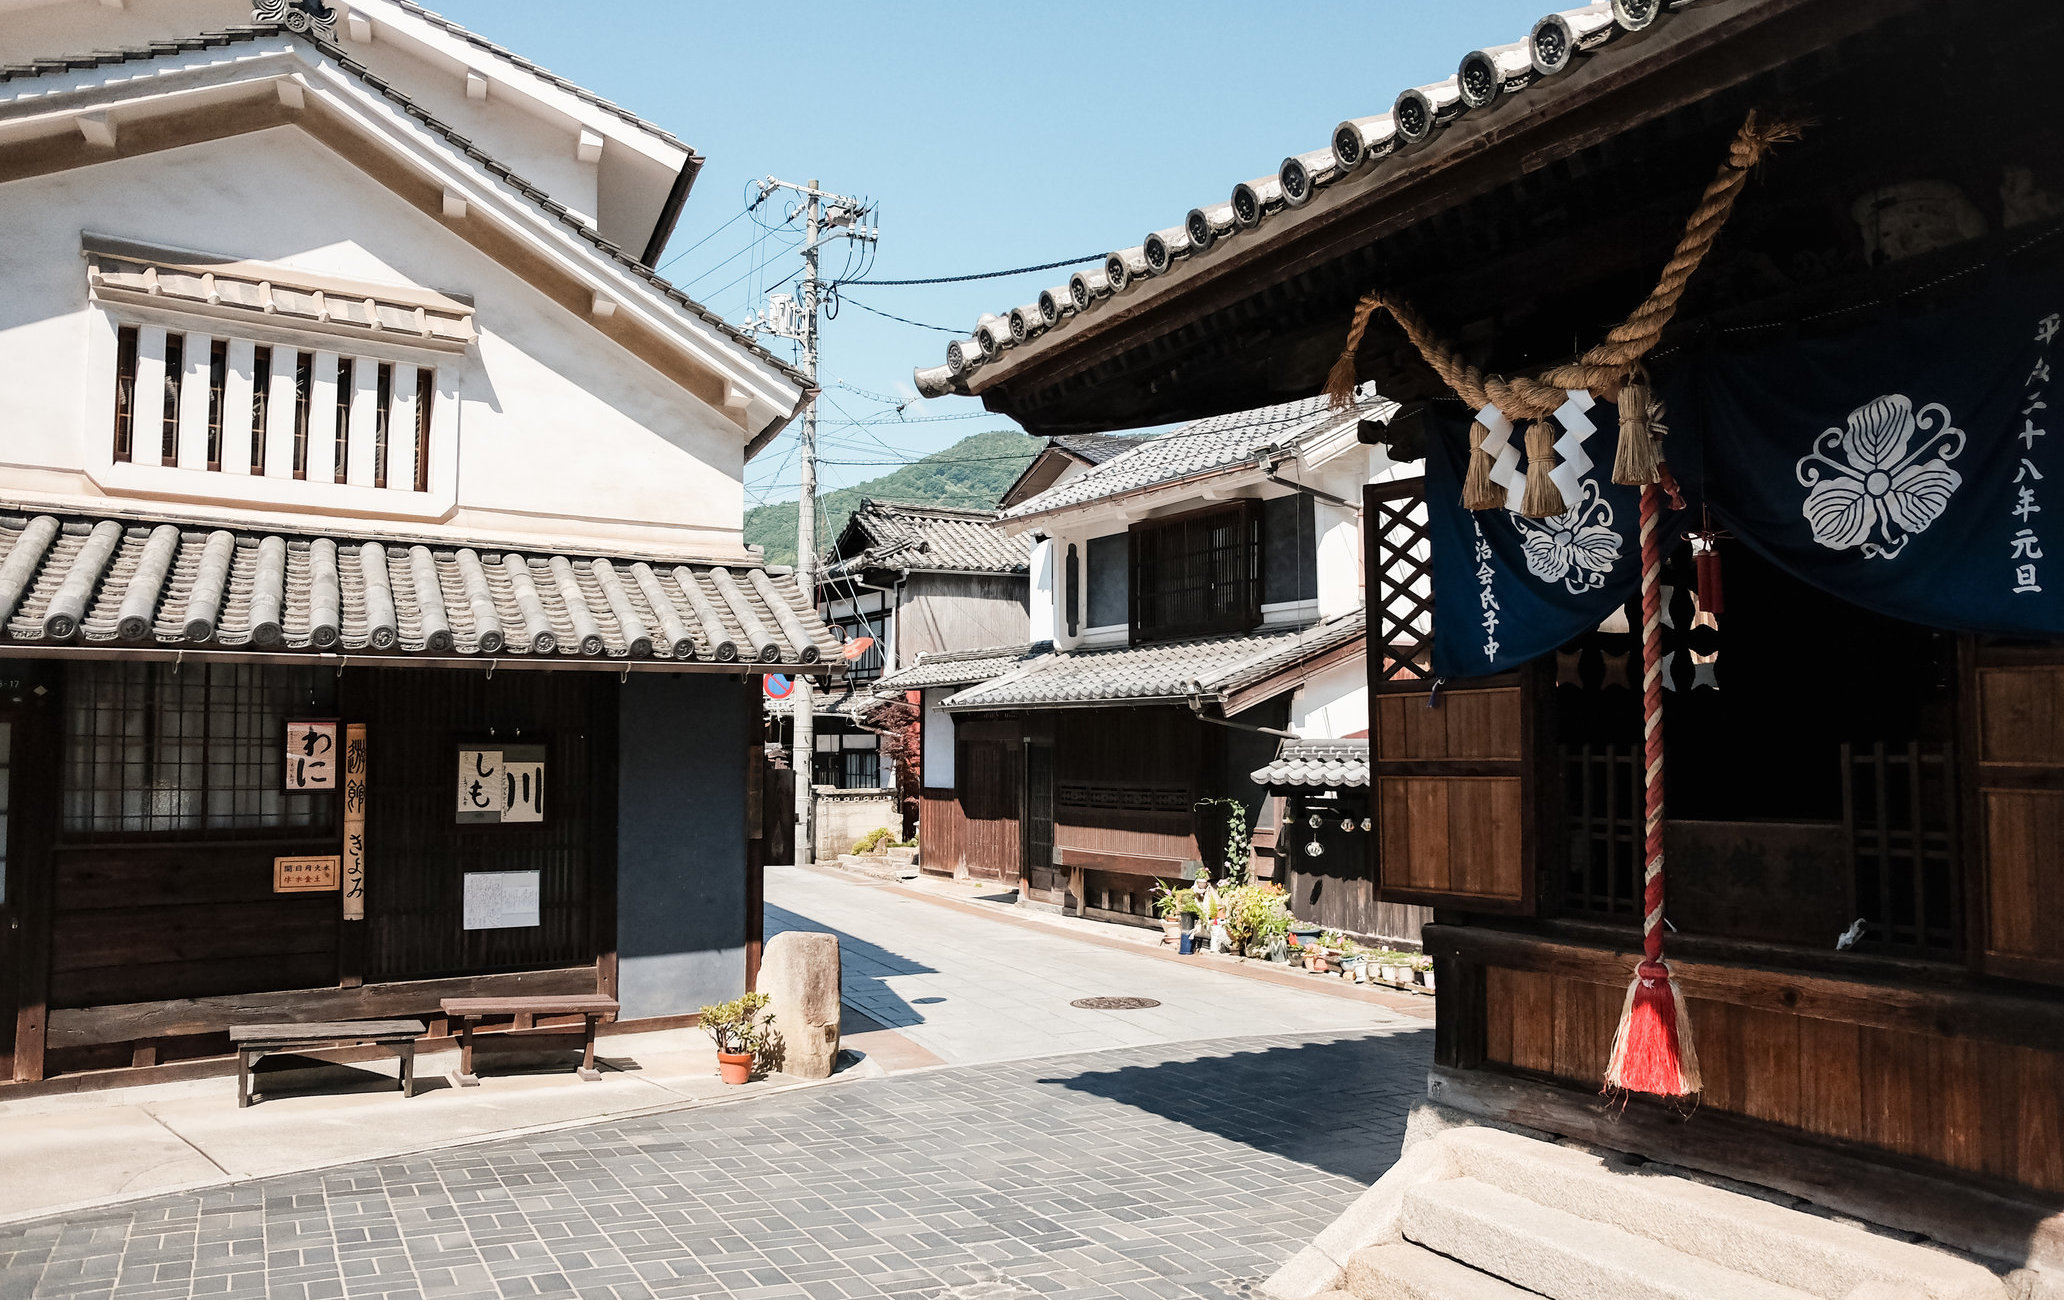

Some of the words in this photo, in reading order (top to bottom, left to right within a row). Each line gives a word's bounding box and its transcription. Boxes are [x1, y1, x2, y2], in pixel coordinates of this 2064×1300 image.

[296, 726, 332, 787] わに
[469, 752, 495, 808] しも
[506, 766, 542, 814] 川
[346, 834, 364, 899] きよみ
